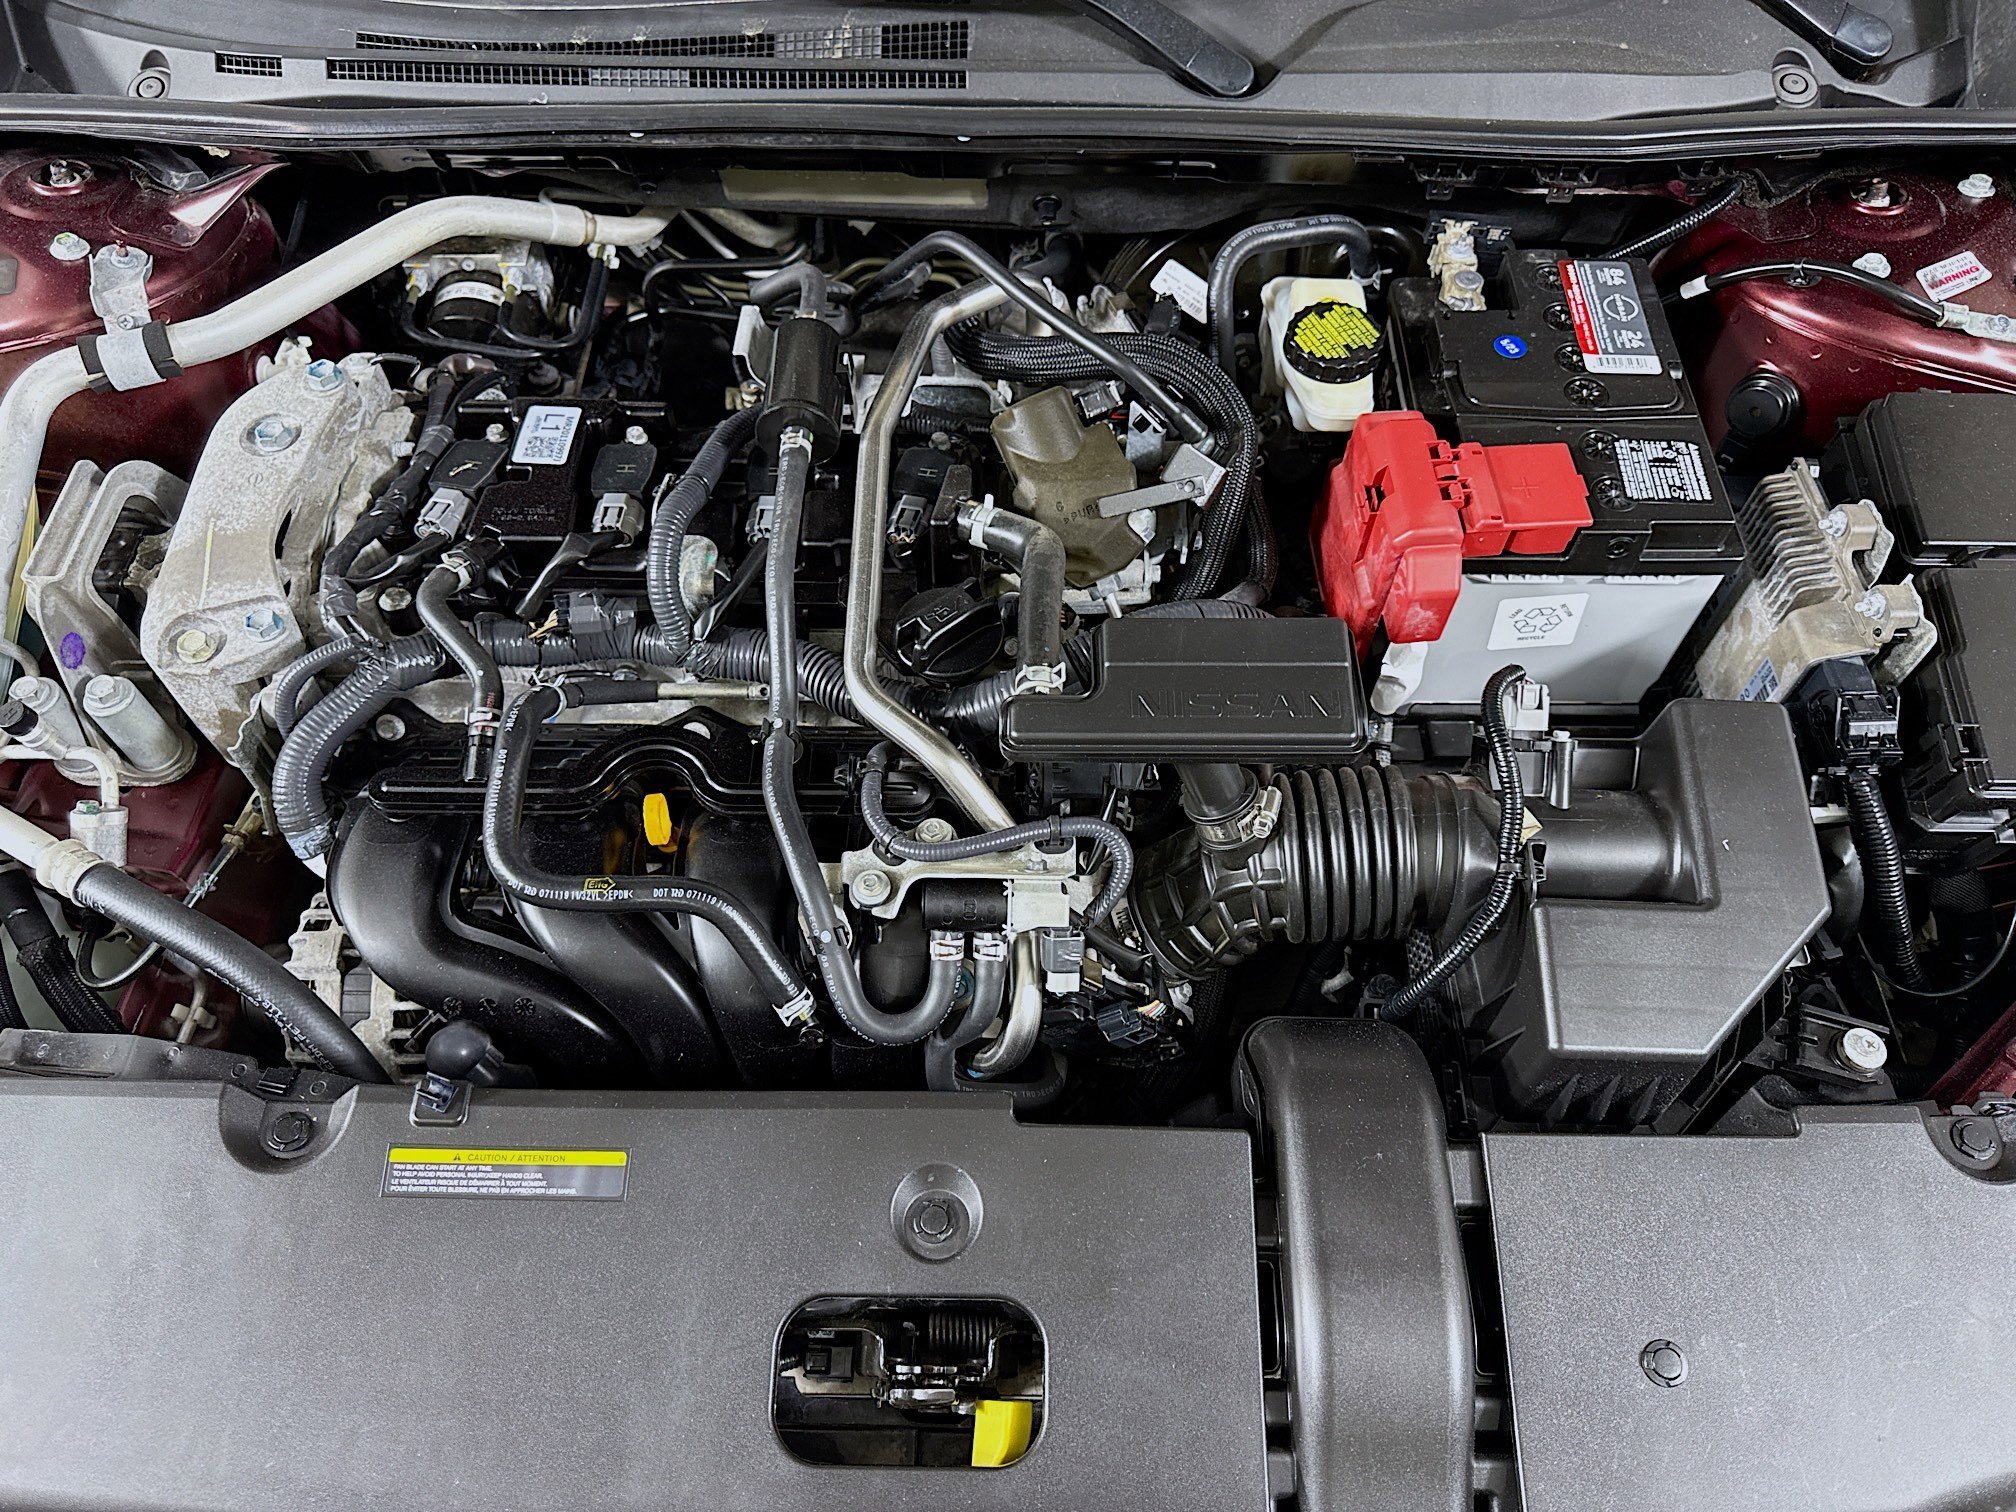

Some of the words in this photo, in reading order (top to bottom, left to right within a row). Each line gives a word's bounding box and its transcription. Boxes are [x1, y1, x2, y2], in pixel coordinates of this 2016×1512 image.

[1610, 268, 1627, 286] 84
[1928, 265, 1980, 290] WARNING
[1627, 330, 1645, 348] 24
[1130, 689, 1342, 718] NISSAN
[498, 749, 508, 763] DOT
[507, 878, 523, 891] DOT
[538, 887, 569, 900] 071119
[653, 888, 667, 898] DOT
[686, 890, 718, 905] 071119
[467, 1154, 508, 1162] CAUTION
[517, 1154, 566, 1163] ATTENTION
